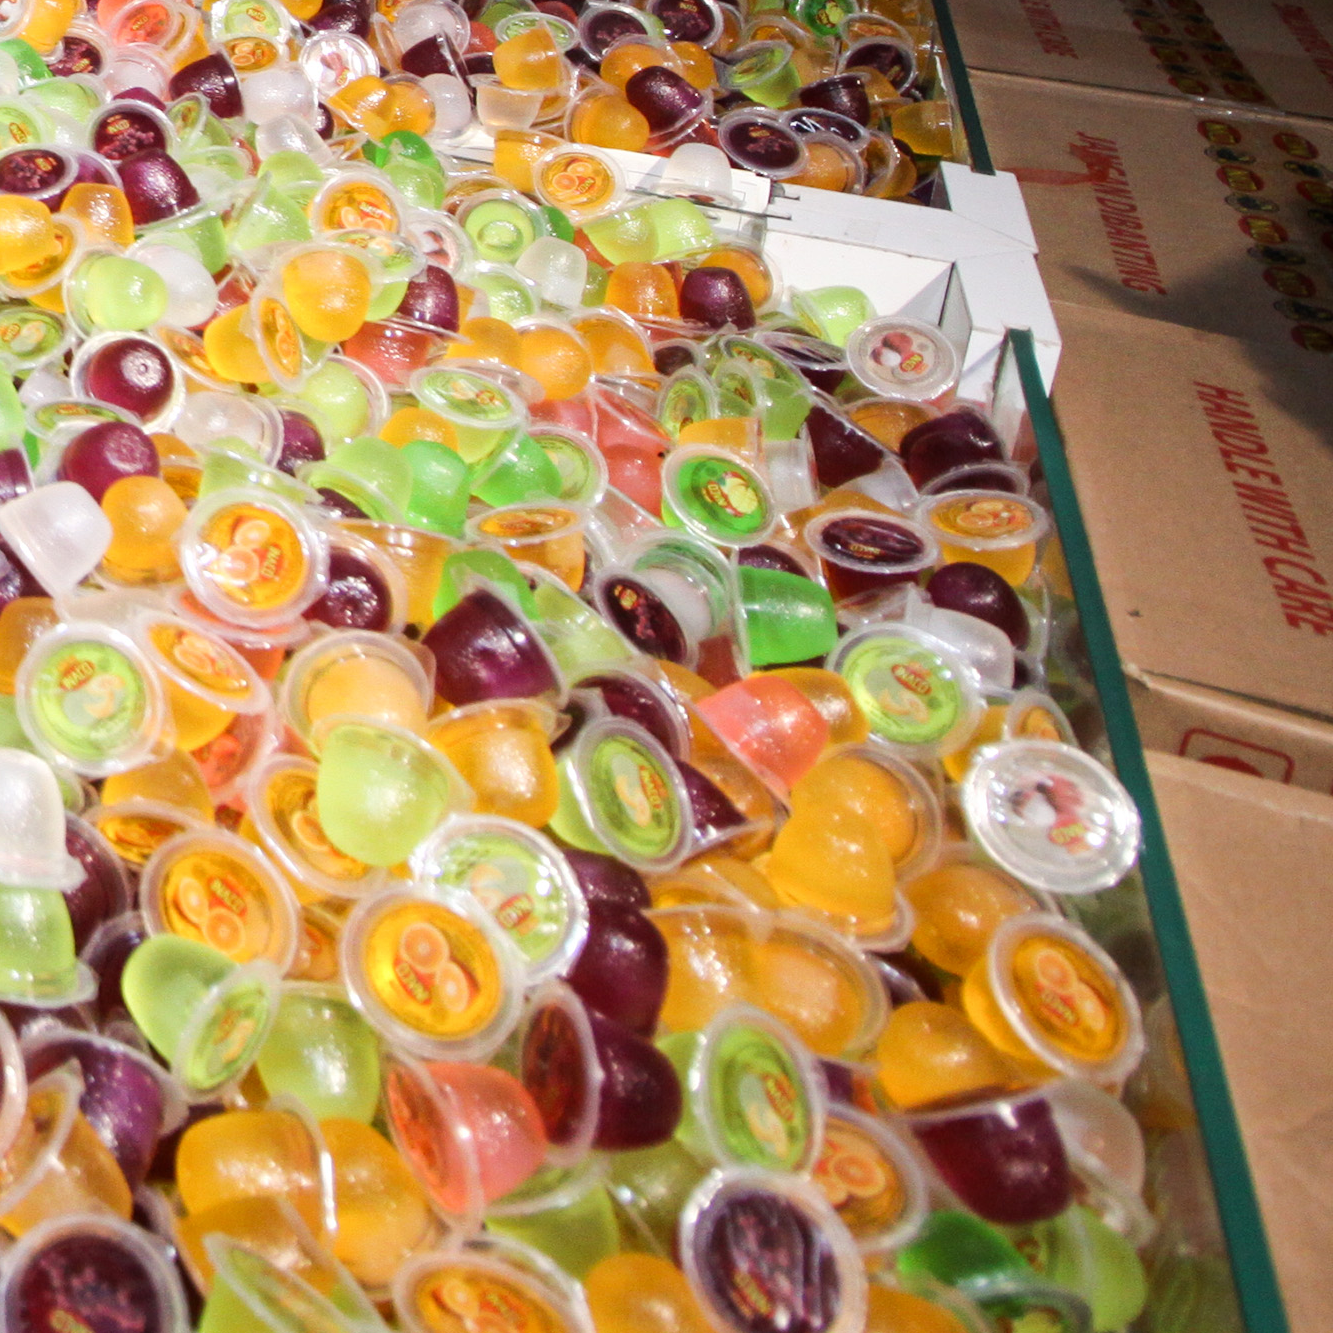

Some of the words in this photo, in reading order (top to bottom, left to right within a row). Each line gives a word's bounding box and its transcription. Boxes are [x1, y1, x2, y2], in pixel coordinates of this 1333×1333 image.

[901, 355, 923, 371] INACO
[1193, 381, 1283, 486] HANDLE
[1233, 480, 1316, 561] WITH
[1263, 556, 1333, 637] CARE
[61, 661, 94, 689] INACO
[893, 667, 931, 693] INACO
